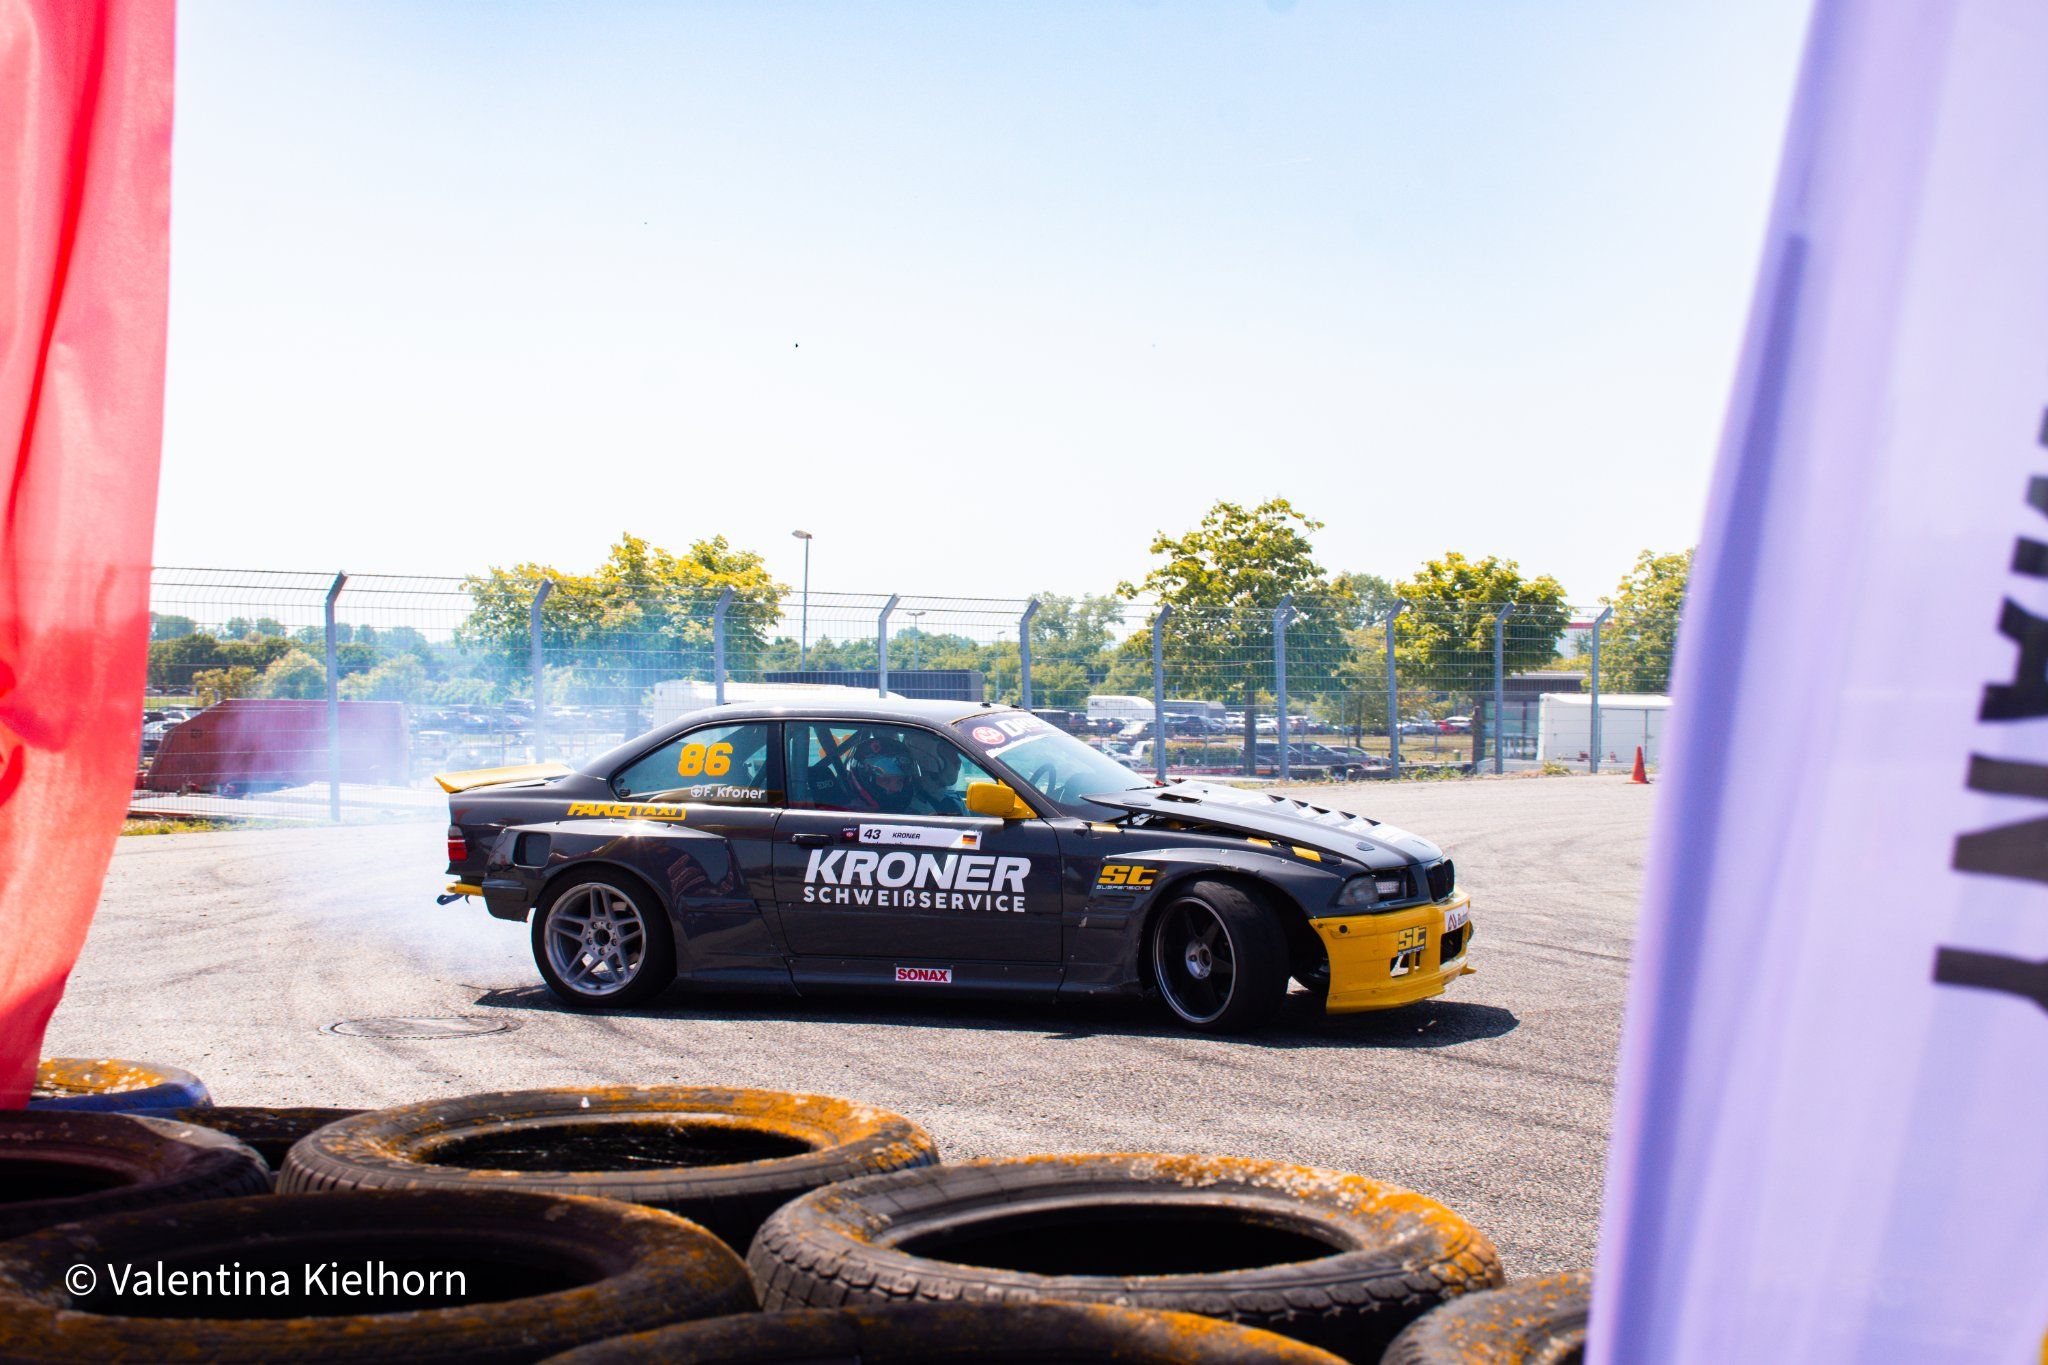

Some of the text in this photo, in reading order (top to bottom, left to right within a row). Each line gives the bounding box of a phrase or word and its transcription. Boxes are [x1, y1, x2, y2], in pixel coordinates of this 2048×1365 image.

[678, 742, 734, 777] 86
[703, 786, 766, 800] F. Kroner
[864, 829, 881, 840] 43
[892, 832, 921, 840] KRONER
[803, 849, 1032, 893] KRONER
[803, 886, 1026, 913] SCHWEIßSERVICE
[897, 968, 948, 982] SONAX
